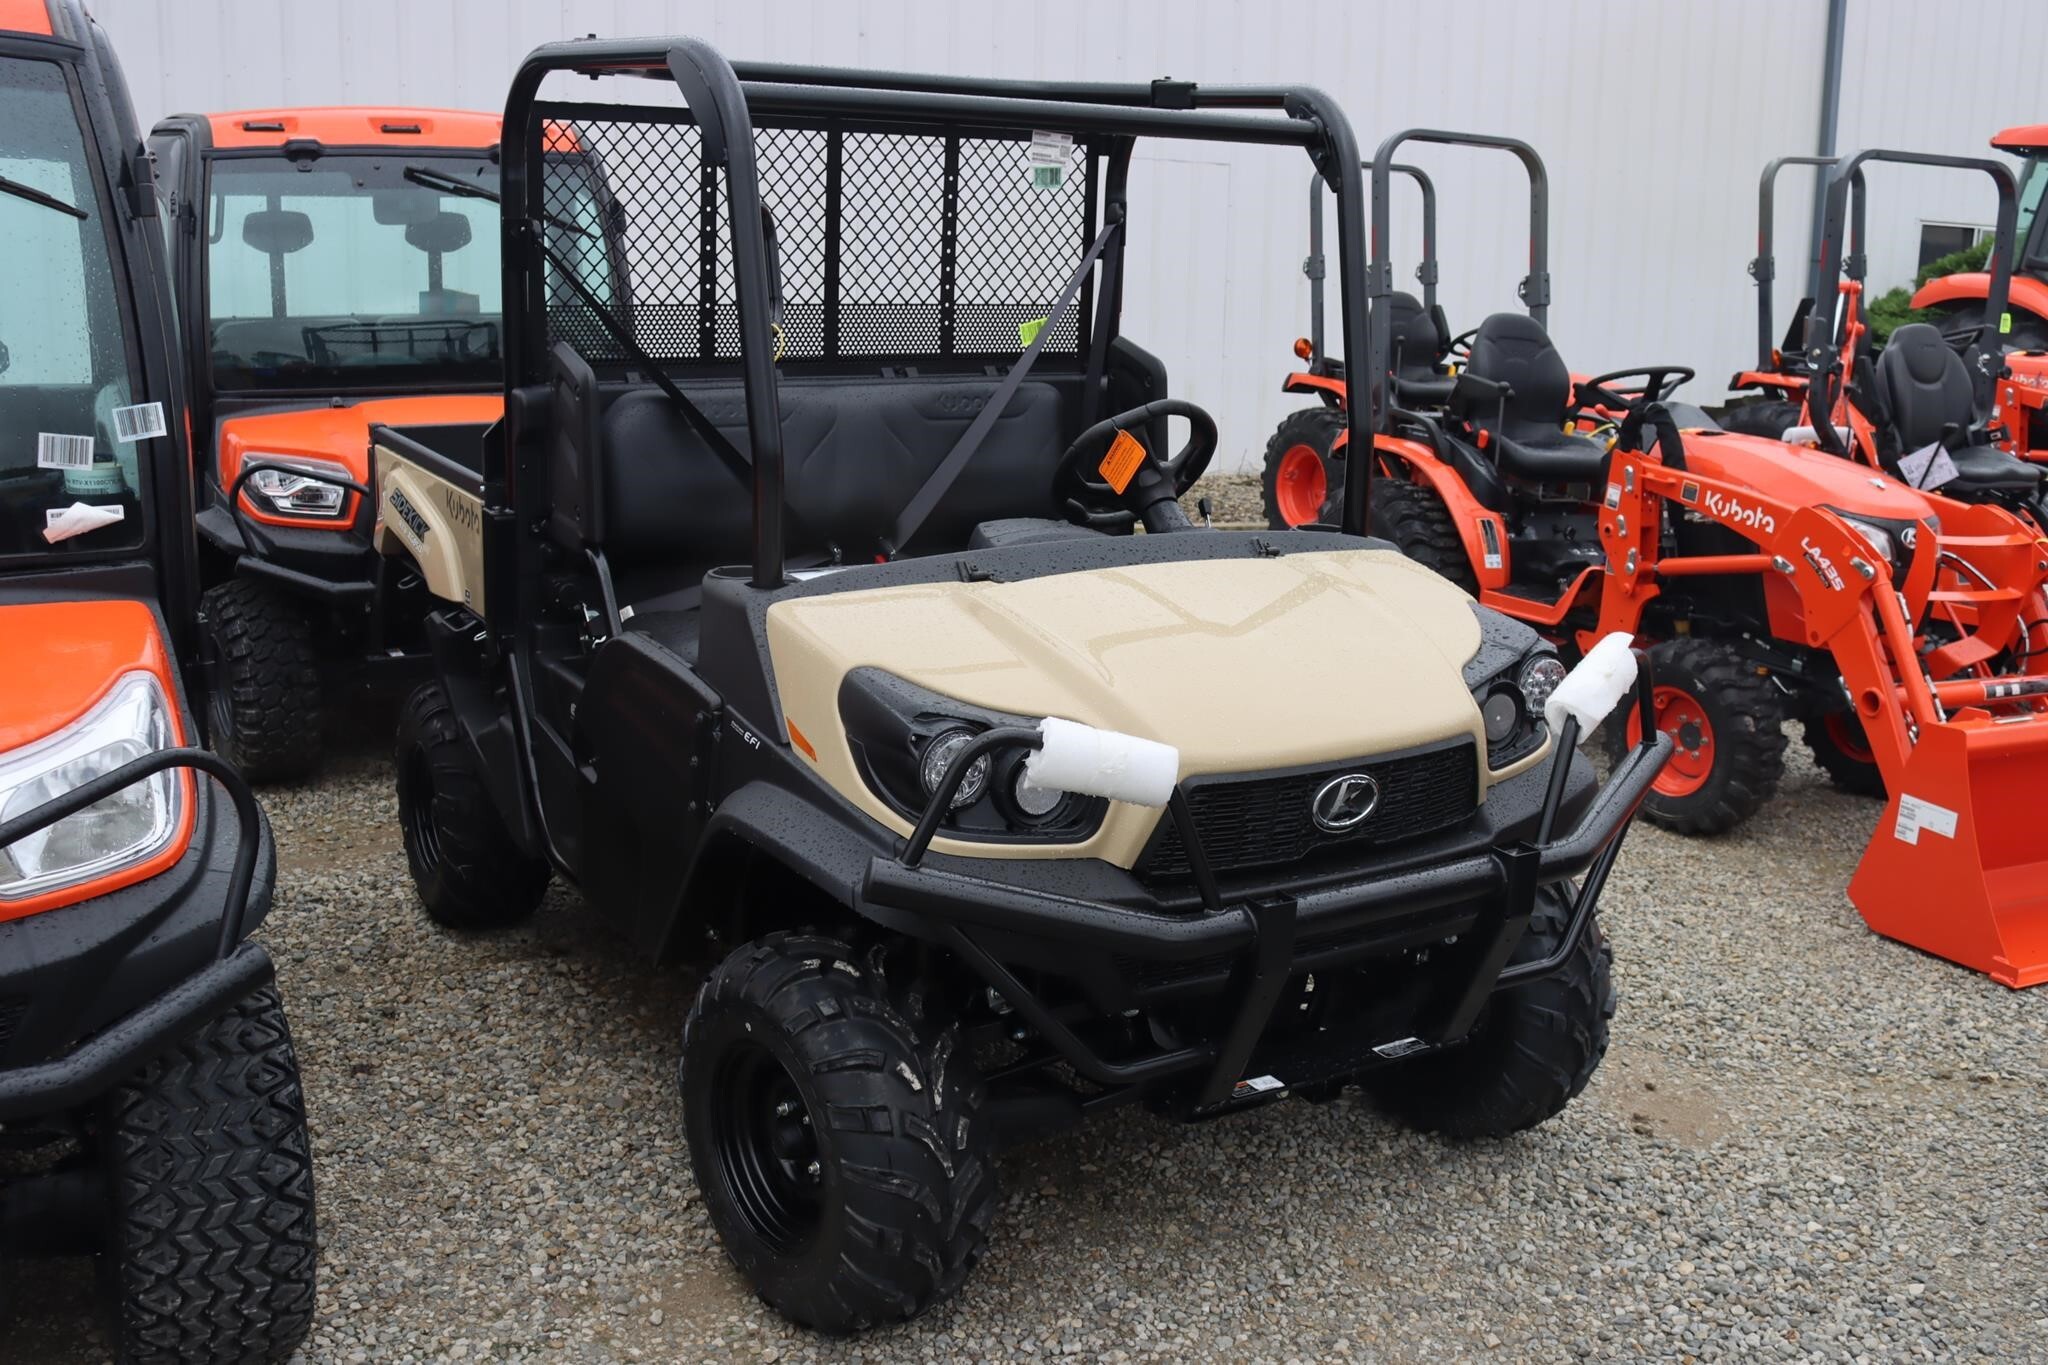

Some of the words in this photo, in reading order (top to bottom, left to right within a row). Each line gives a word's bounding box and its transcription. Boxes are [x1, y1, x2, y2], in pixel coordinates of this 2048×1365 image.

[391, 488, 429, 542] SIDEKICK
[445, 487, 480, 535] Kubota
[1704, 490, 1775, 534] Kubota
[1800, 536, 1845, 592] LA435
[743, 731, 761, 750] EFI
